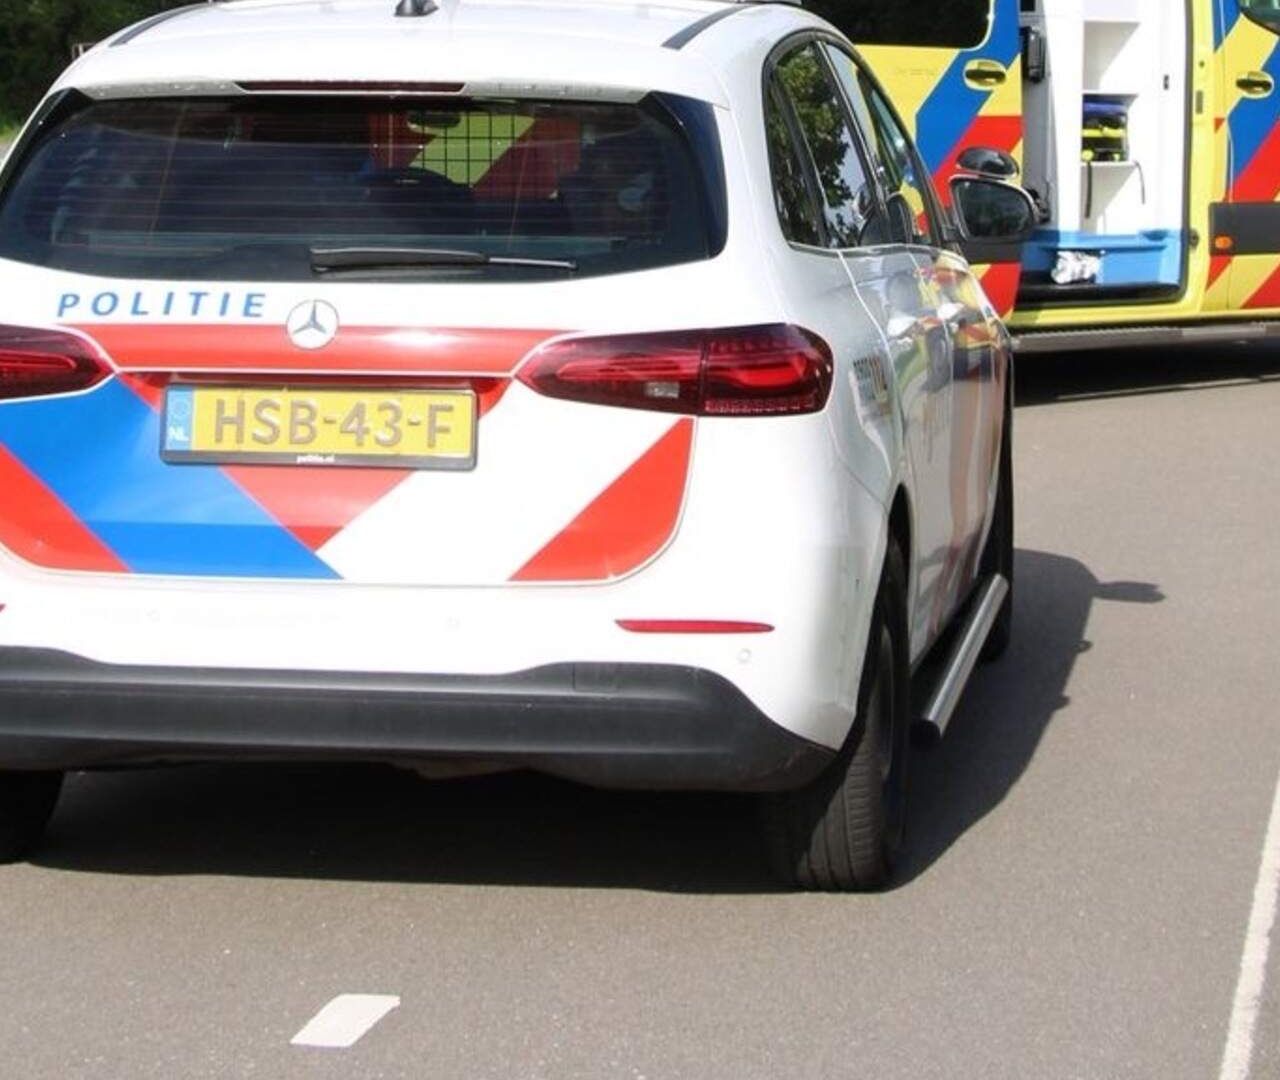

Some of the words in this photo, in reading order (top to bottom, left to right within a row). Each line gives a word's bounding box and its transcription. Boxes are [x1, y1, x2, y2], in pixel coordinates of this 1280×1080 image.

[57, 291, 266, 318] POLITIE
[170, 426, 189, 441] NL
[214, 399, 454, 448] HSB-43-F
